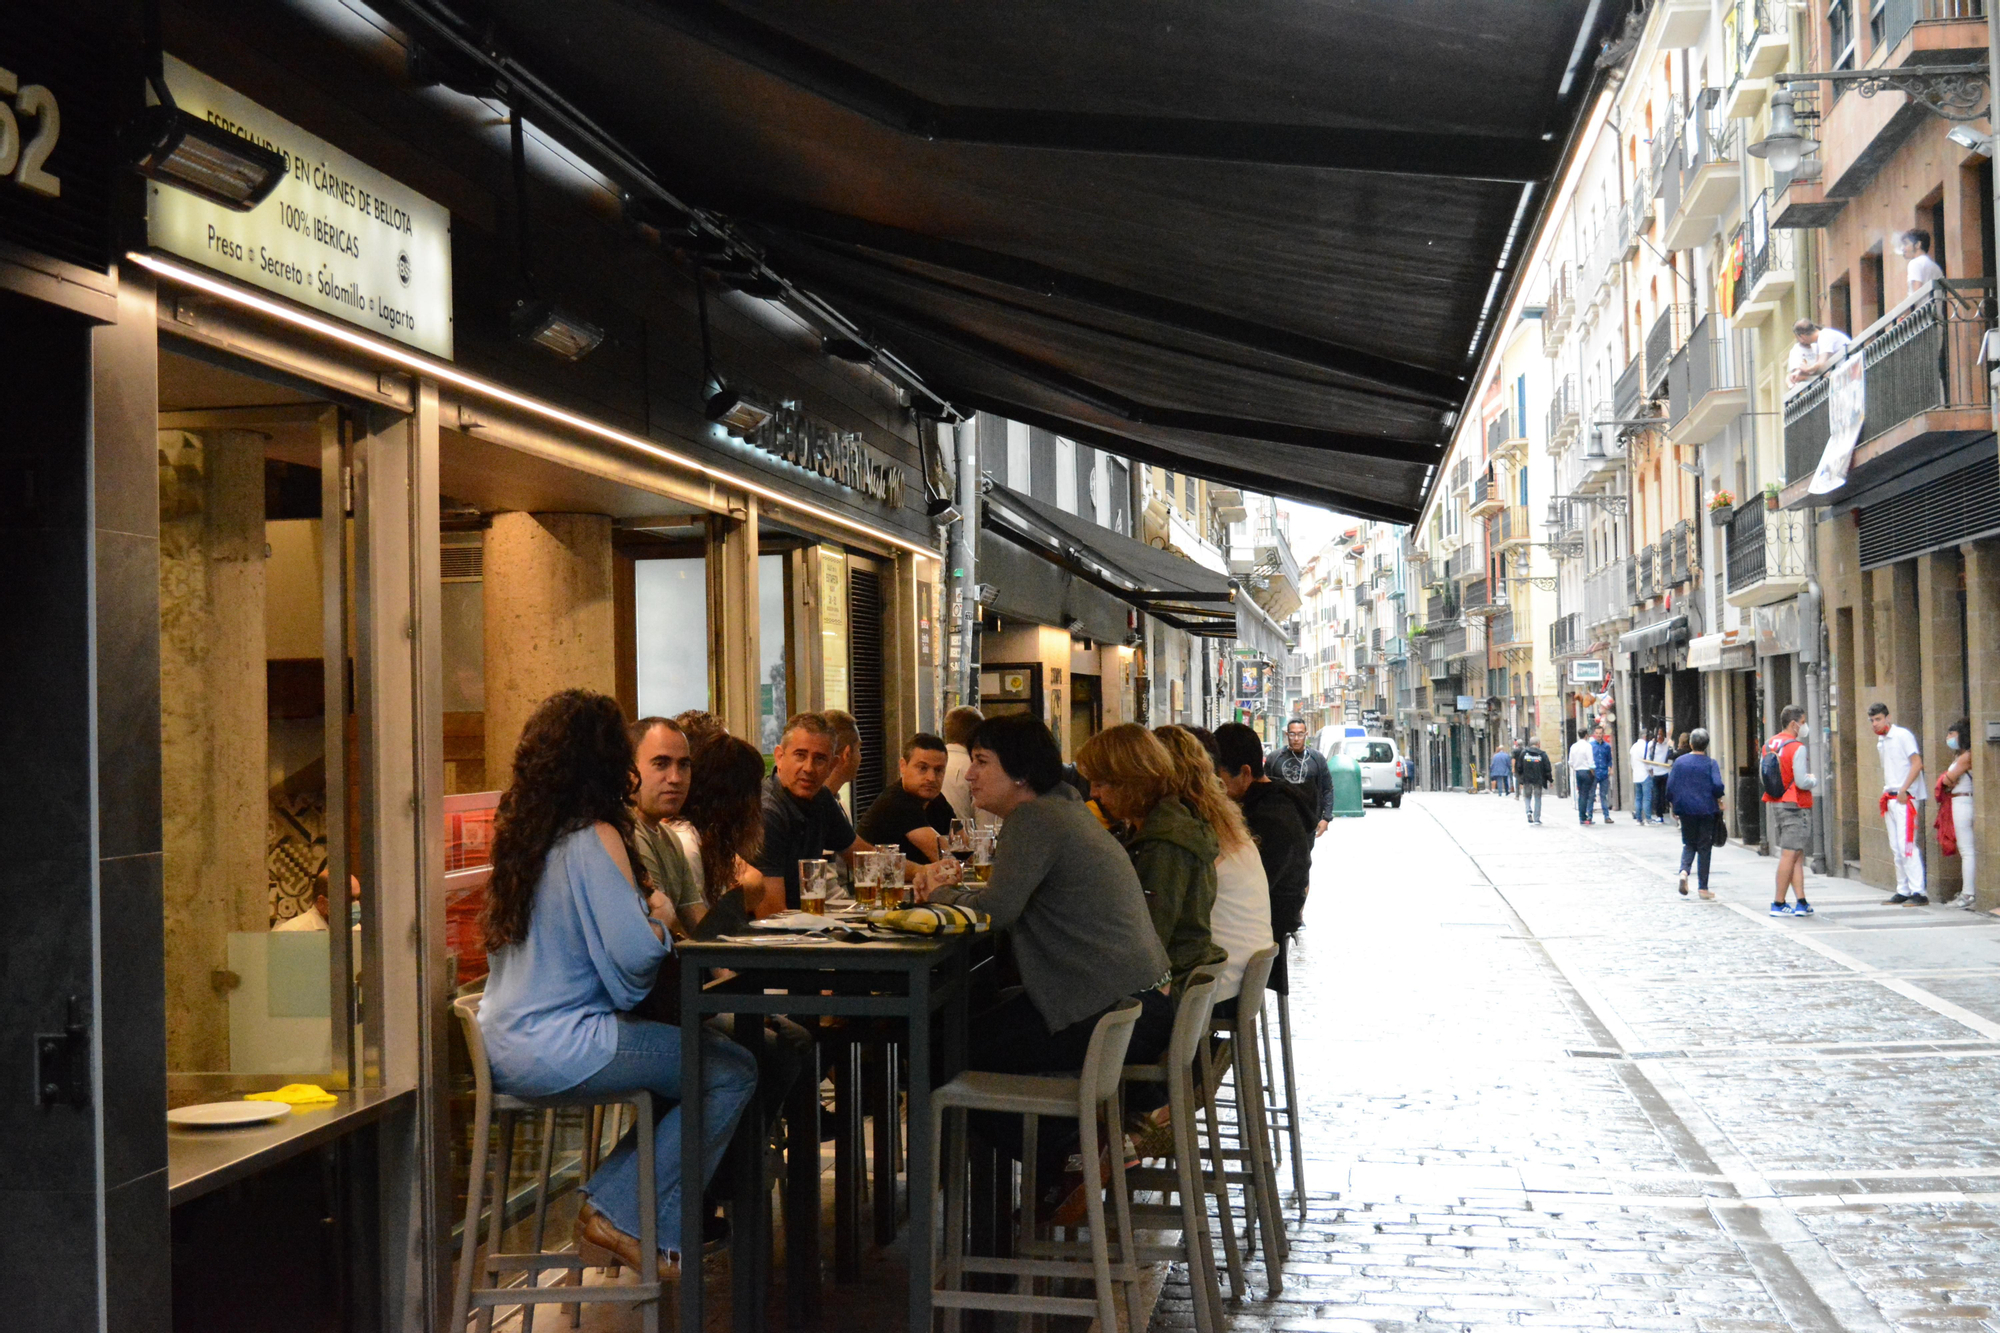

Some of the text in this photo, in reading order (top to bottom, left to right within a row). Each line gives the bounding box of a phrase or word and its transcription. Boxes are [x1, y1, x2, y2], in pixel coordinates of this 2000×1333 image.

[280, 201, 360, 259] 100% IBÉRICAS
[295, 157, 311, 186] EN
[313, 167, 355, 208] CARNES
[358, 189, 372, 221] DE
[374, 197, 413, 237] BELLOTA
[208, 224, 415, 330] Presa Secreto Solomillo Lagarto
